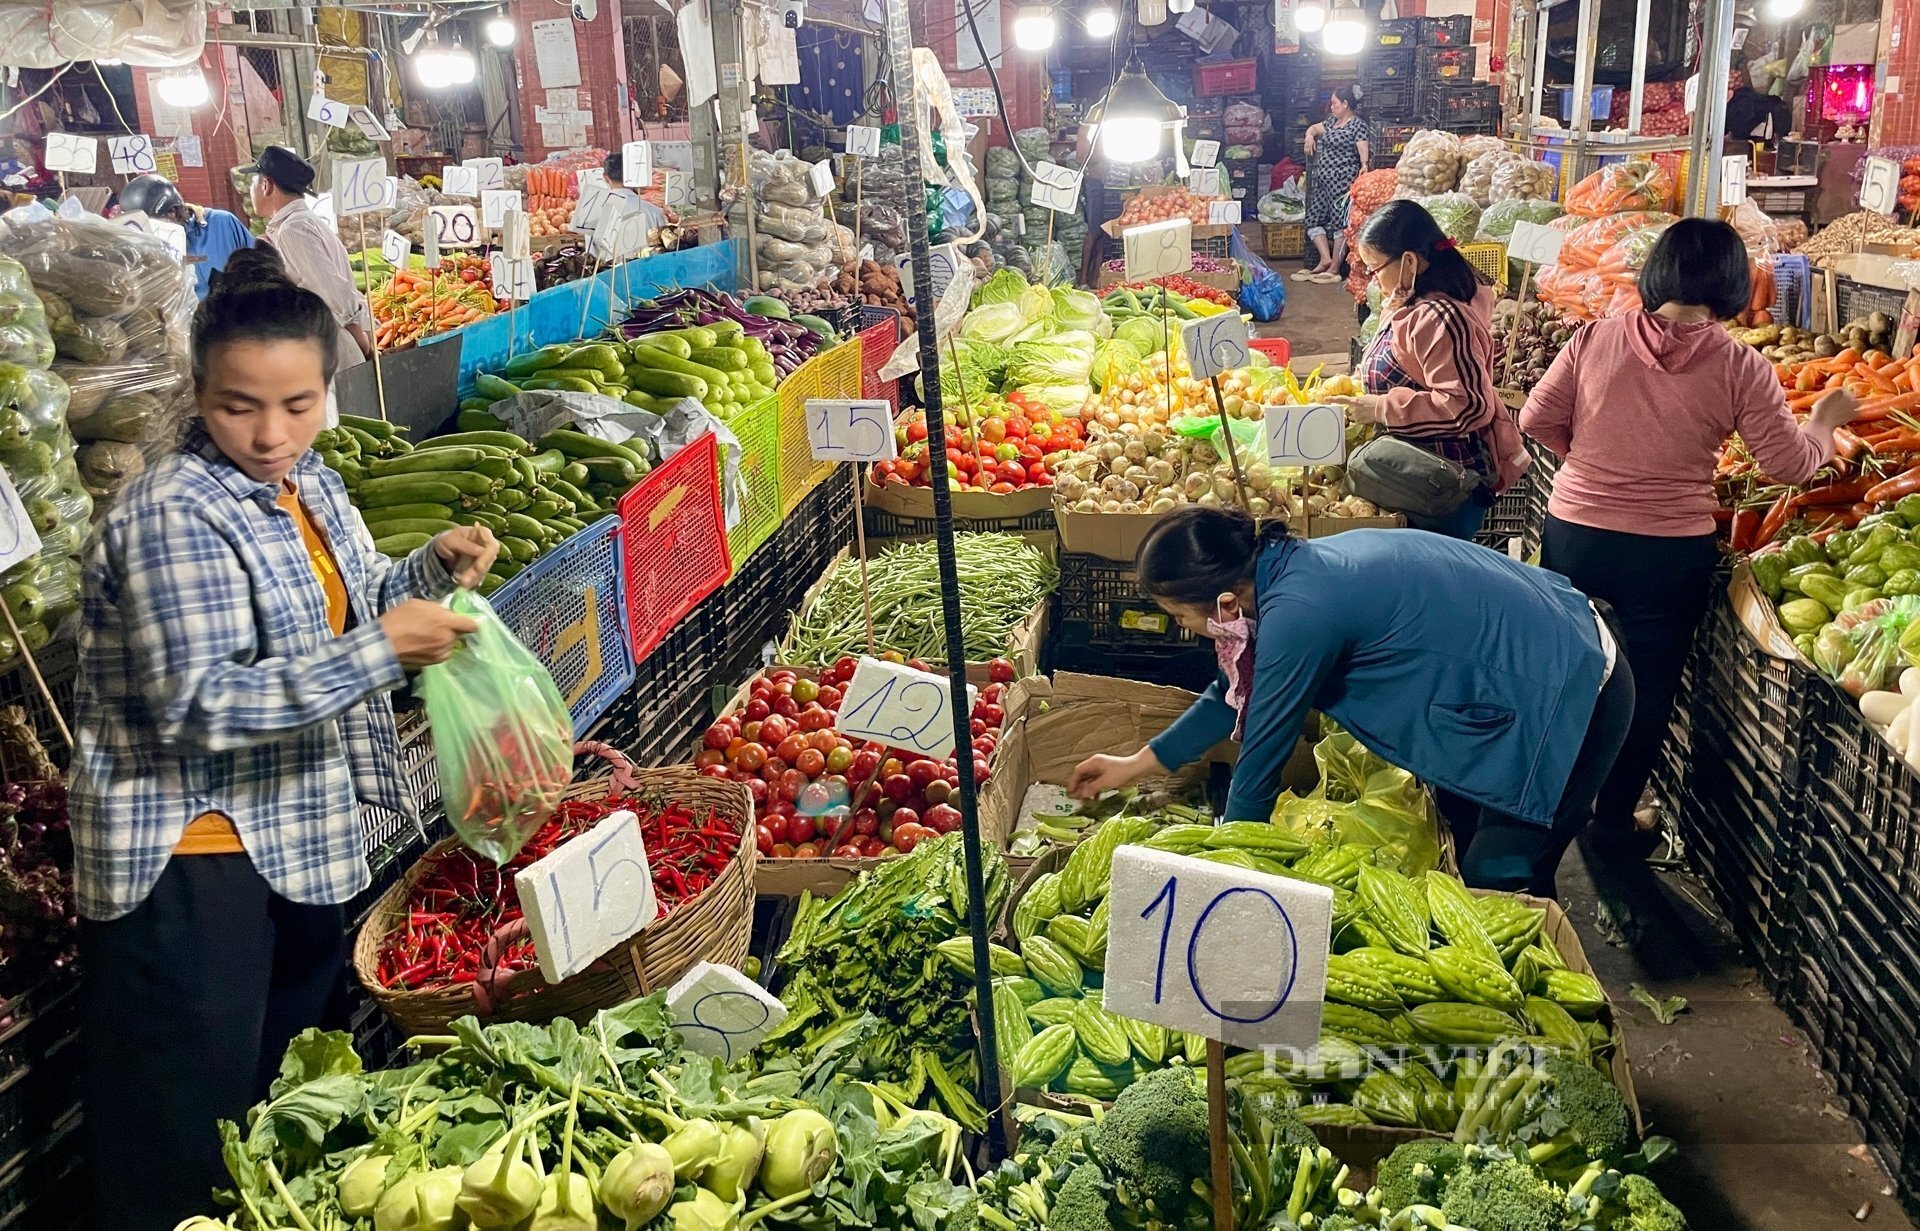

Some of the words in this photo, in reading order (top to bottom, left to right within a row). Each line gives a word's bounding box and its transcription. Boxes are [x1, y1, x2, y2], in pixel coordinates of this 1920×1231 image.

[49, 134, 95, 171] 35
[111, 135, 155, 171] 48
[847, 127, 874, 155] 12
[343, 160, 386, 212] 16
[444, 167, 472, 194] 12
[1210, 202, 1241, 224] 40
[1130, 228, 1183, 278] 18
[1194, 319, 1245, 378] 16
[814, 407, 886, 457] 15
[1270, 406, 1341, 461] 10
[843, 675, 954, 751] 12
[548, 814, 646, 979] 15
[1139, 875, 1299, 1024] 10
